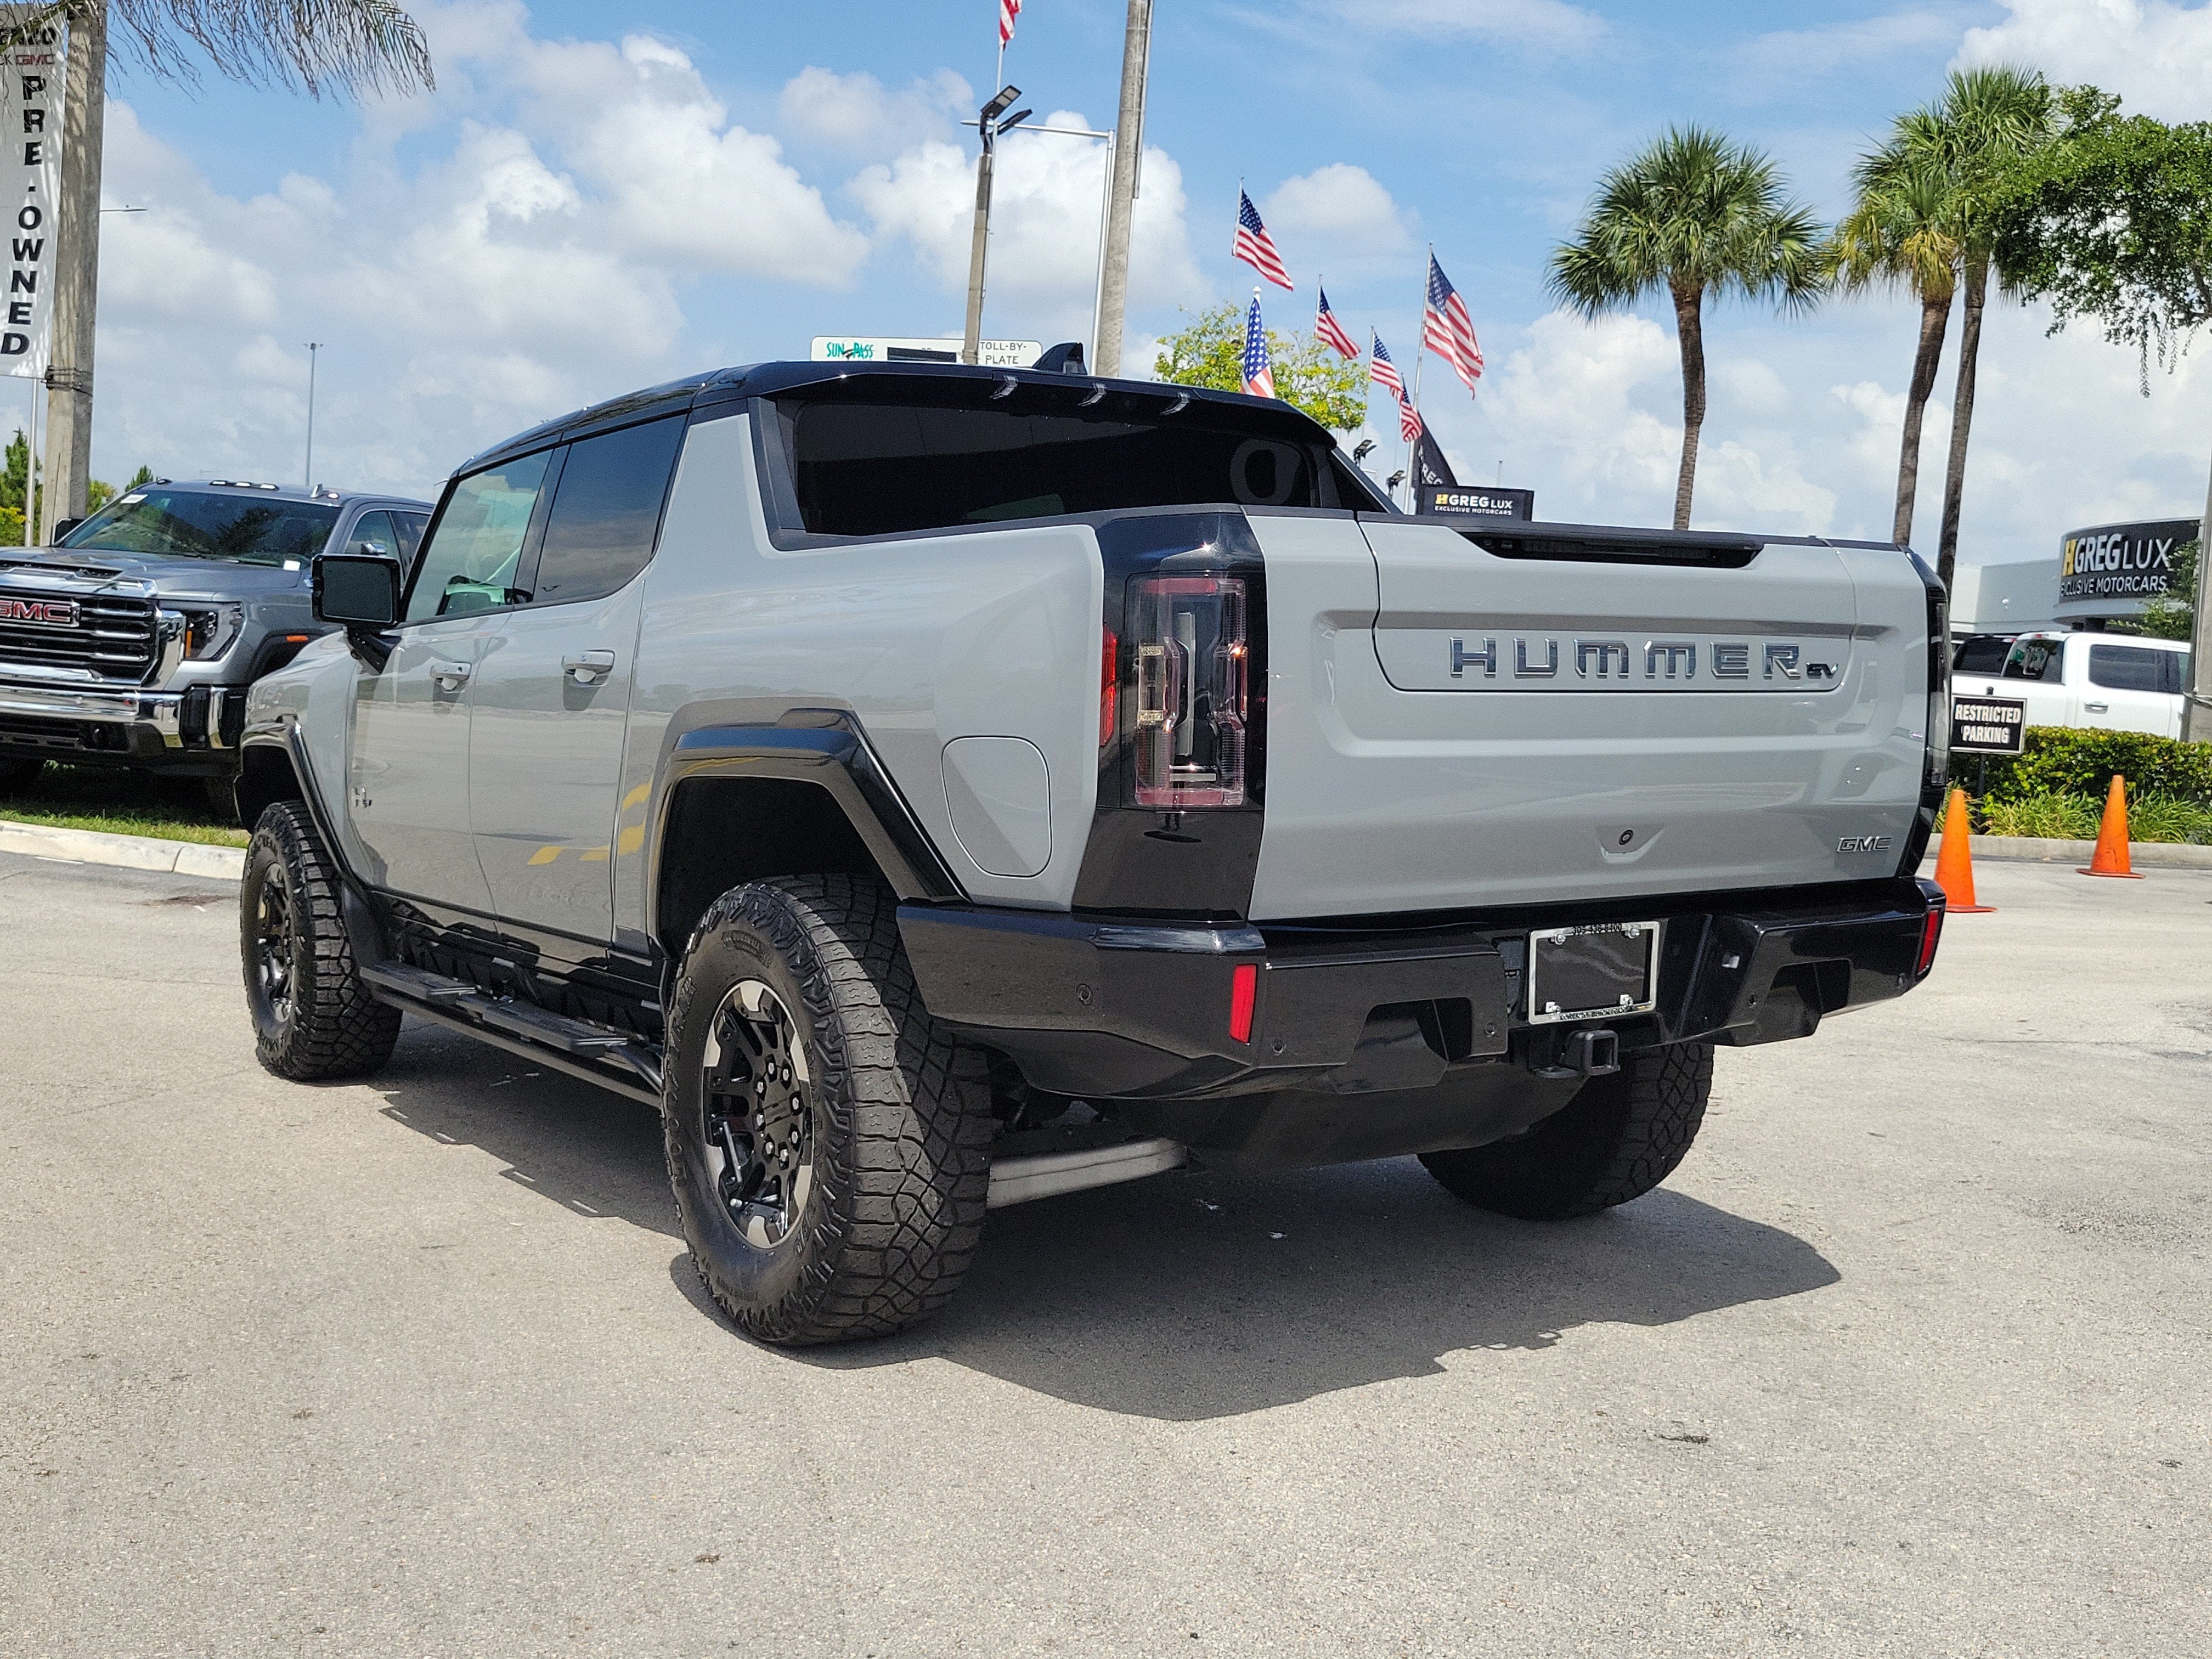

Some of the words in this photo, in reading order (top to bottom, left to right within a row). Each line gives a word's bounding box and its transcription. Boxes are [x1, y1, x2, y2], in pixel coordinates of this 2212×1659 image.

[986, 355, 1019, 365] PLATE
[1472, 507, 1512, 516] MOTORCARS
[2096, 575, 2167, 593] MOTORCARS
[1449, 637, 1801, 679] HUMMER
[1955, 704, 2022, 723] RESTRICTED
[1962, 725, 2010, 743] PARKING
[1836, 836, 1893, 853] GMC
